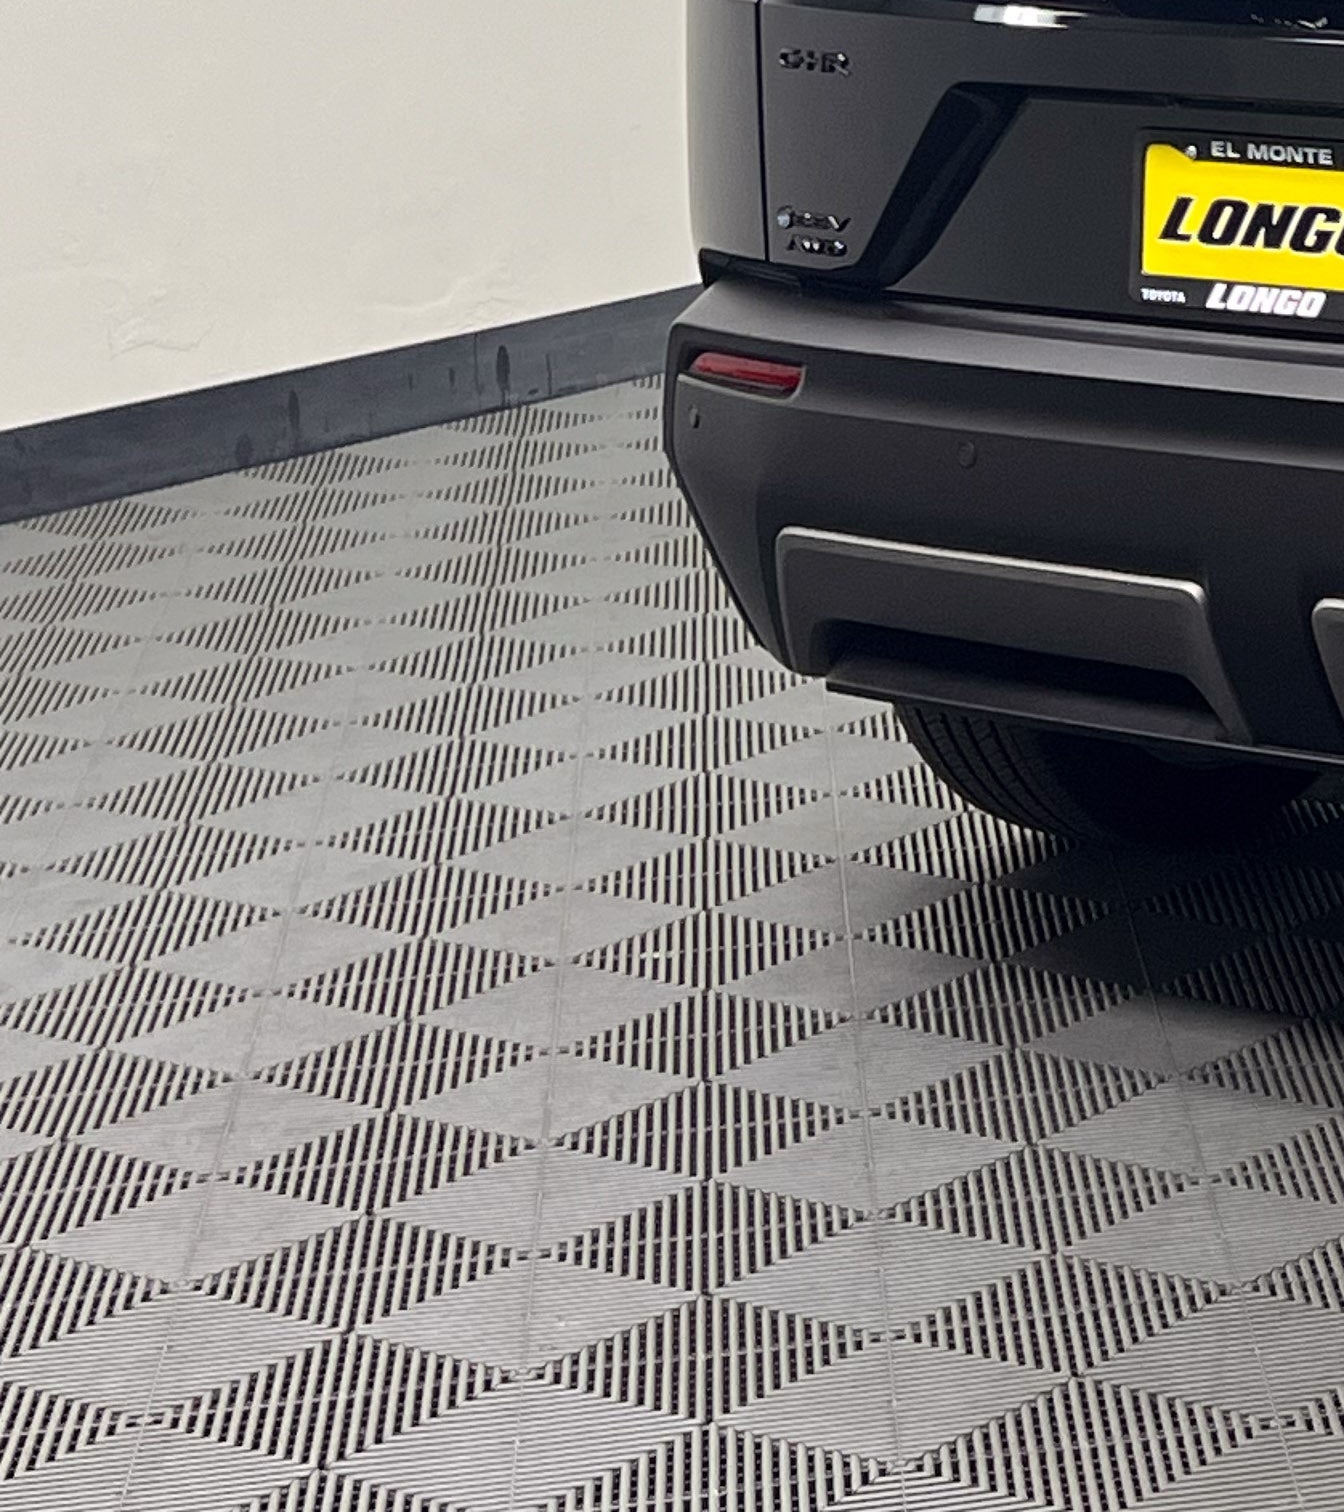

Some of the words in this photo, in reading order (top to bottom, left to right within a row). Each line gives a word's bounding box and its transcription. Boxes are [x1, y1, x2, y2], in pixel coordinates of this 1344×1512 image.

[1210, 140, 1241, 159] EL
[1247, 142, 1334, 166] MONTE
[1140, 287, 1186, 304] TOYOTA
[1205, 282, 1327, 318] LONGO
